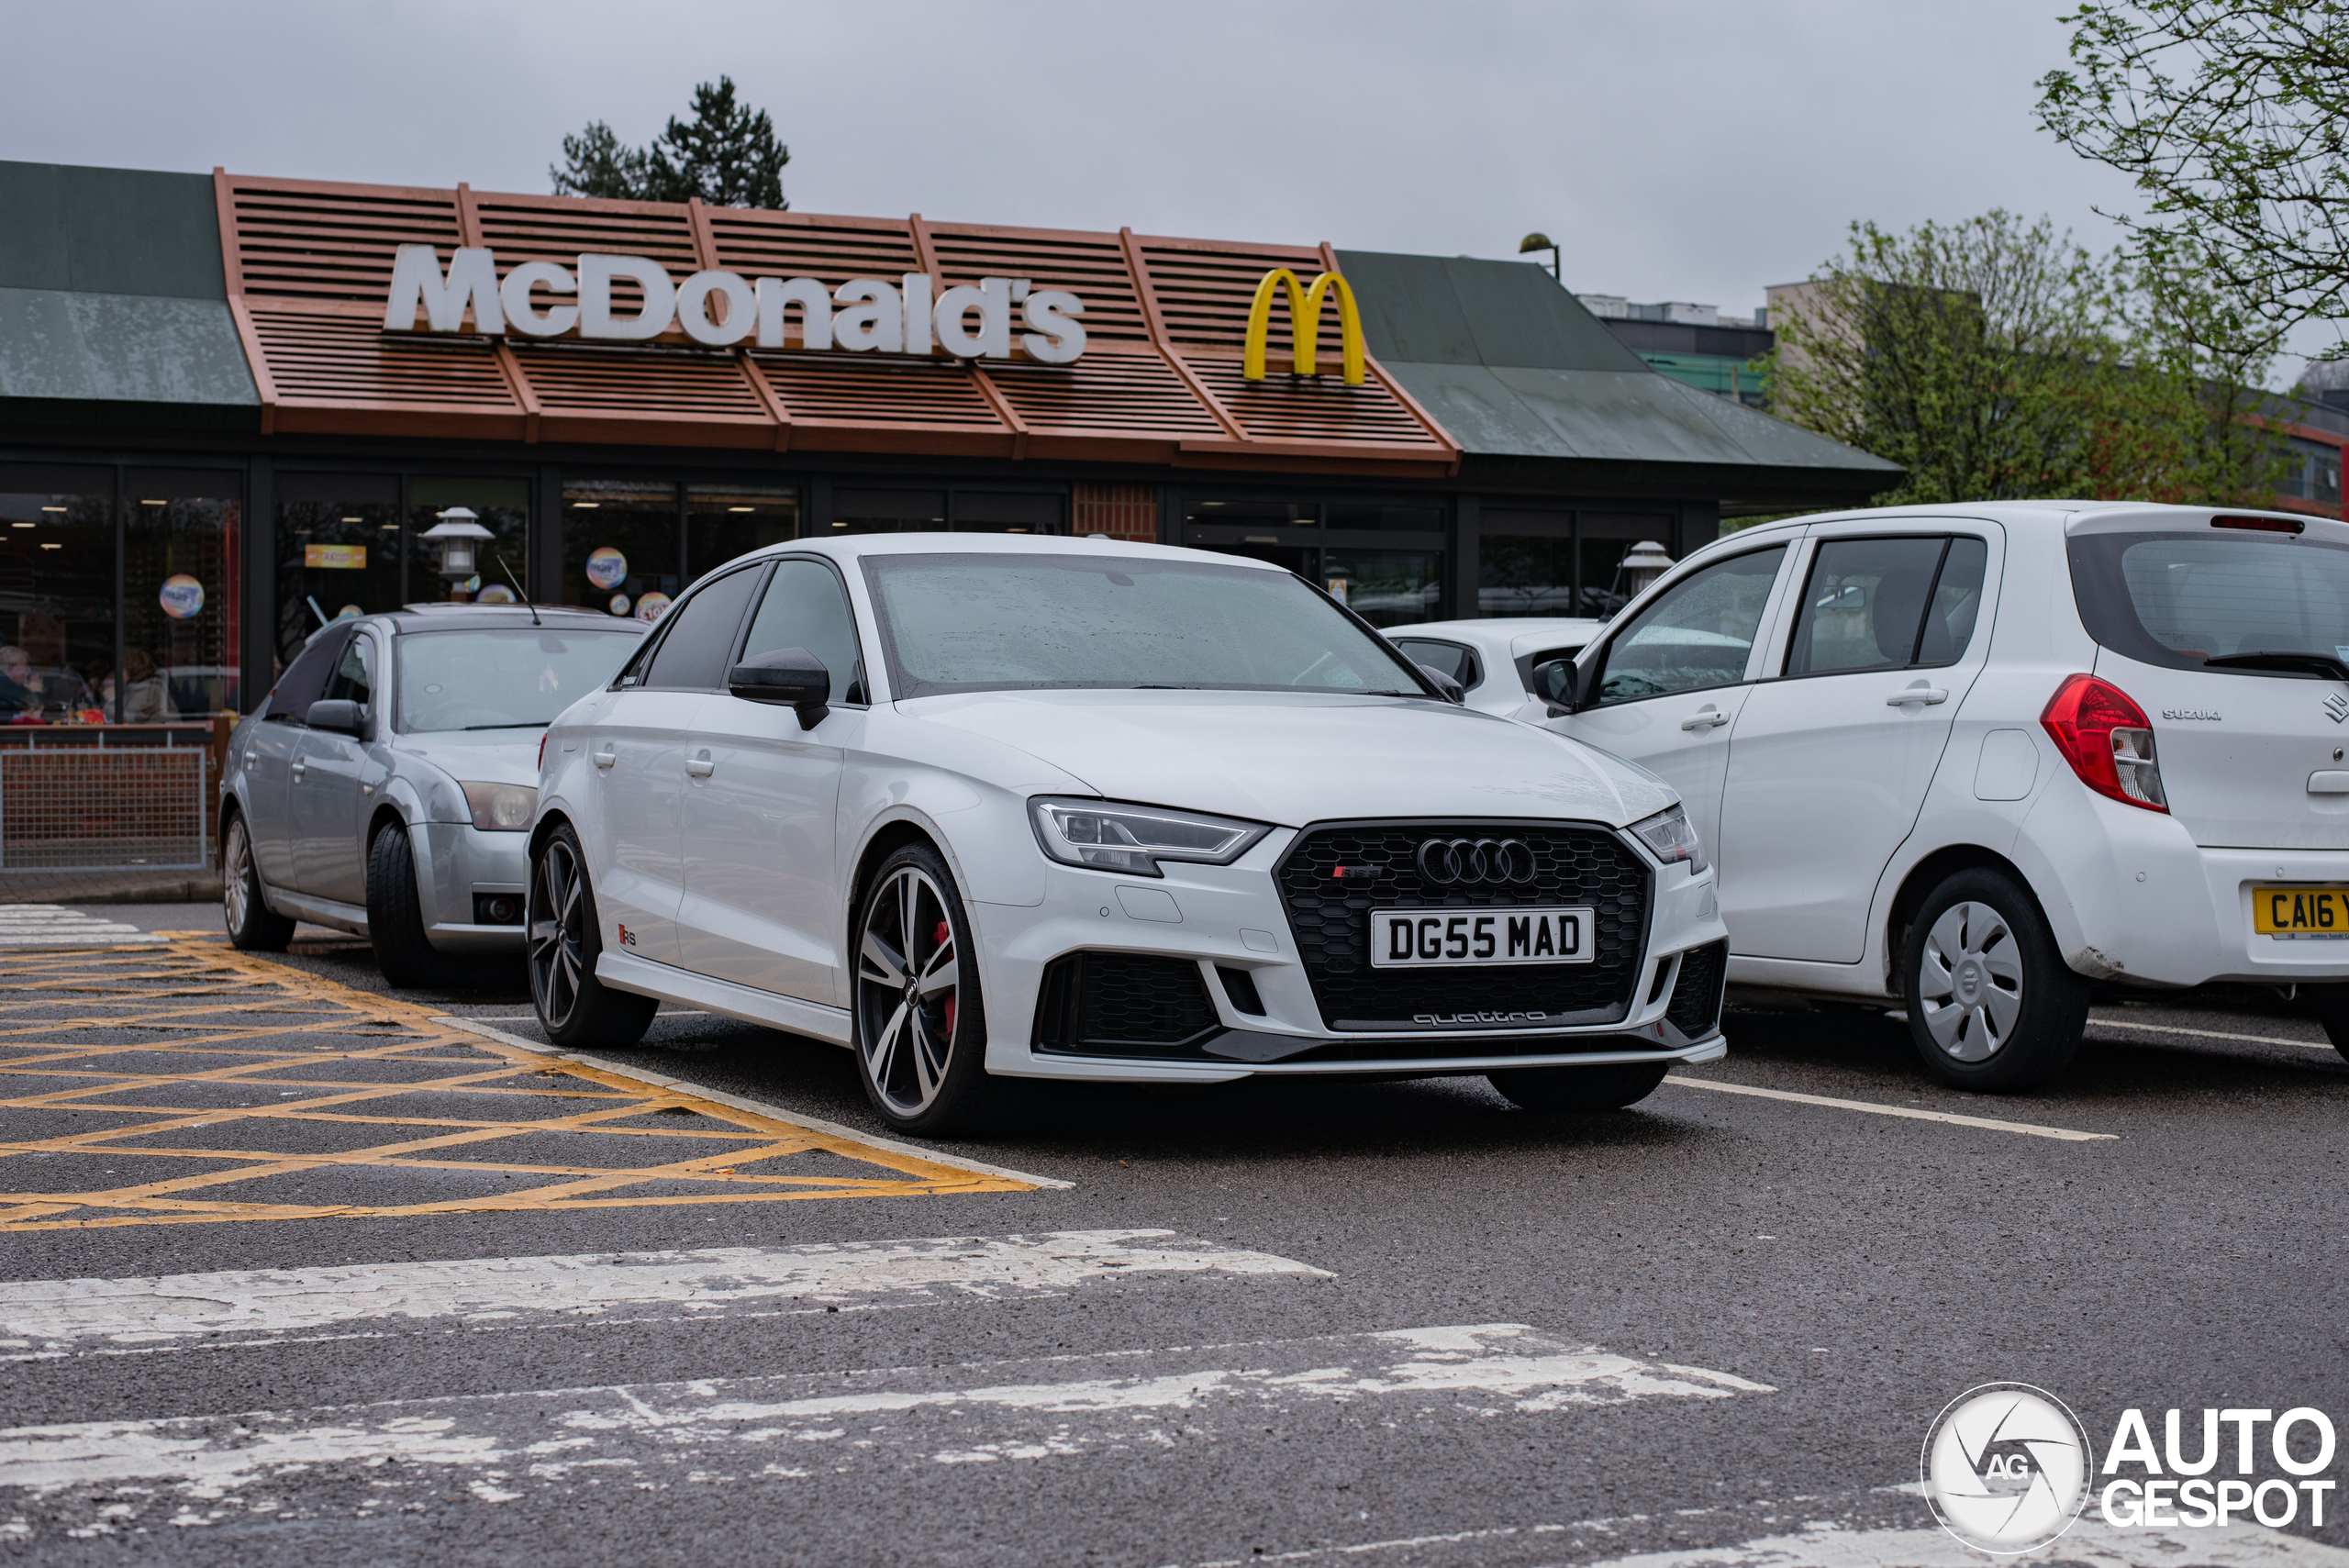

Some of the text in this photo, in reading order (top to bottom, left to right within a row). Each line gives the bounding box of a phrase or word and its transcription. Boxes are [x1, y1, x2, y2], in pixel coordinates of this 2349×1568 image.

[382, 243, 1088, 364] McDonald's
[2162, 708, 2222, 721] SUZUKI
[1340, 867, 1383, 877] RS3
[932, 868, 962, 938] NEXEN
[2271, 894, 2334, 929] CA16
[622, 929, 636, 946] RS
[1389, 914, 1579, 960] DG55 MAD
[1413, 1010, 1547, 1027] quattro
